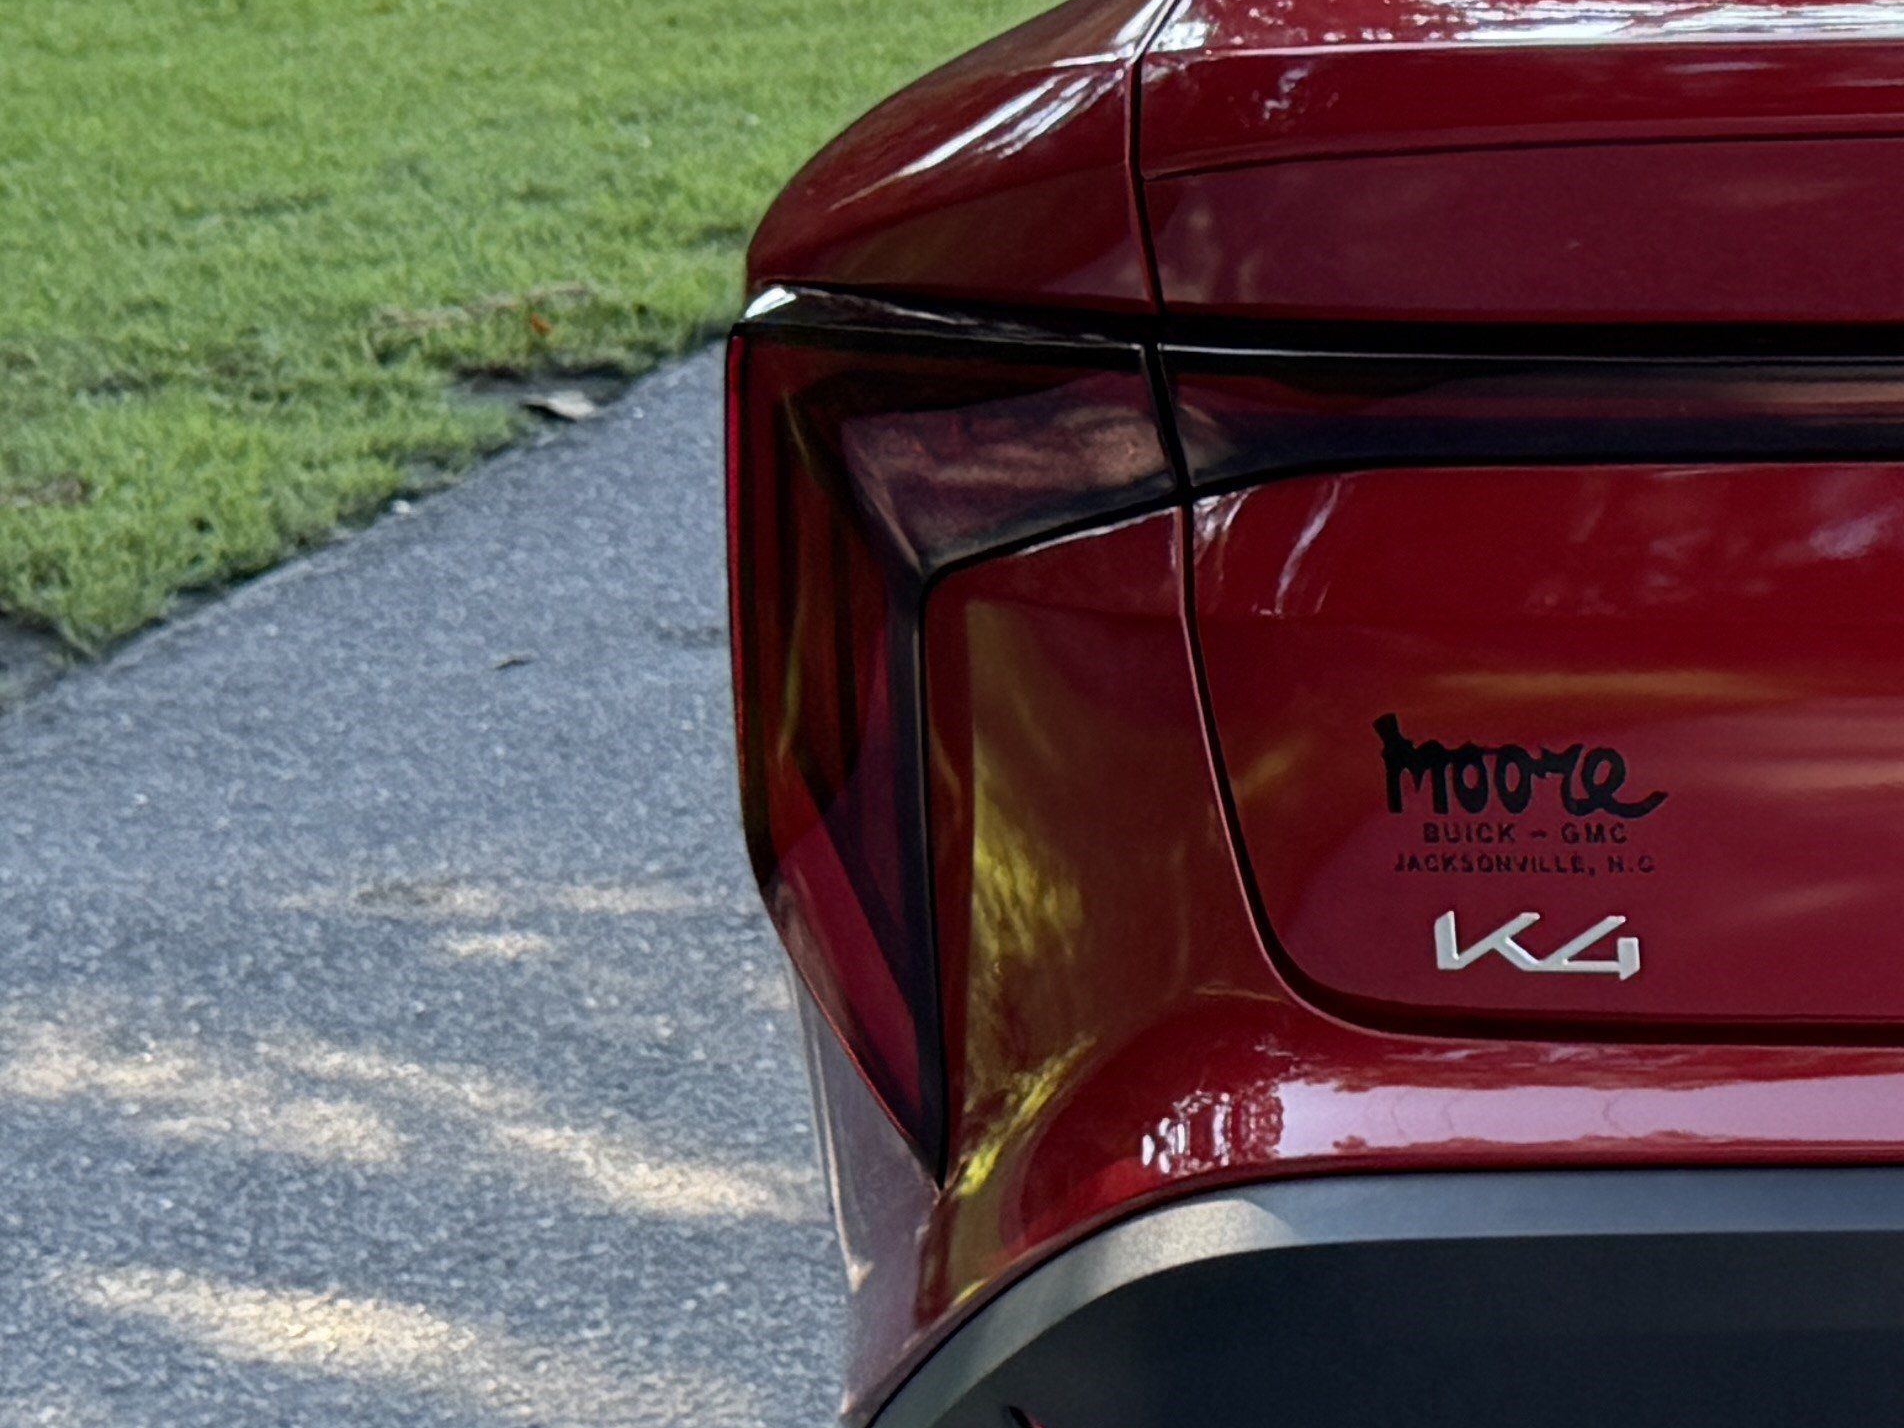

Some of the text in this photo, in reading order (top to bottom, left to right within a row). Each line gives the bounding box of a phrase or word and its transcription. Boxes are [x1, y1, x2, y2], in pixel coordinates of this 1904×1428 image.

[1423, 822, 1516, 844] BUICK
[1560, 822, 1628, 844] GMC
[1394, 853, 1596, 876] JACKSONVILLE,
[1434, 910, 1640, 981] K4
